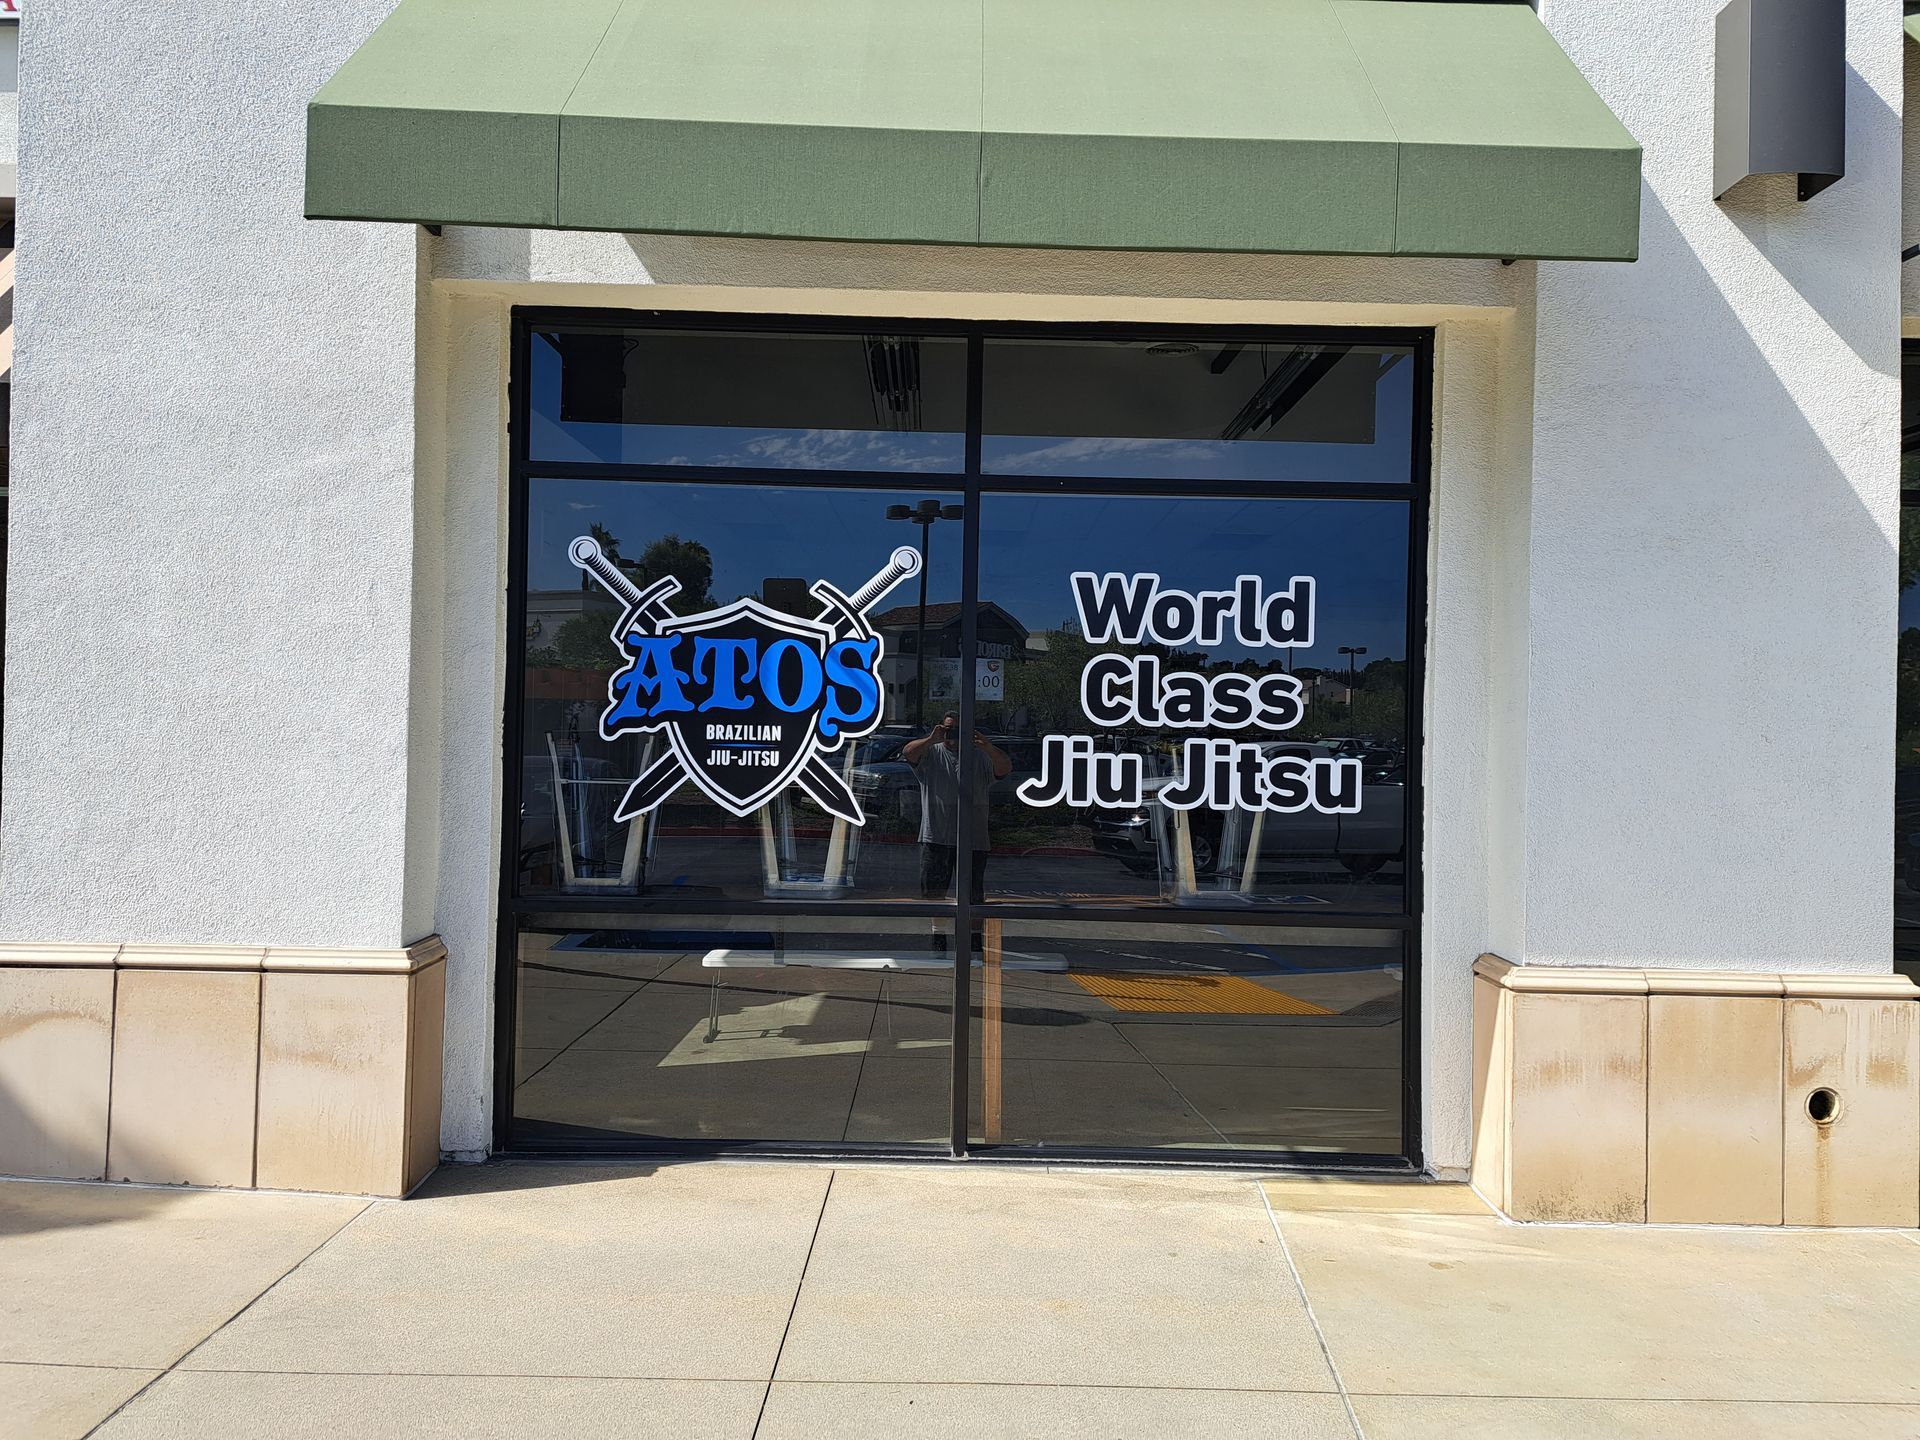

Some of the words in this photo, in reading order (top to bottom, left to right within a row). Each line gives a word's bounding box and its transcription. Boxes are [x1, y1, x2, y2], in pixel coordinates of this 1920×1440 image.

[1070, 571, 1316, 648] World
[607, 633, 878, 737] ATOS
[1081, 653, 1304, 730] Class
[706, 724, 782, 741] BRAZILIAN
[706, 749, 780, 767] JIU-JITSU
[1016, 735, 1142, 808] Jiu
[1158, 738, 1363, 814] Jitsu
